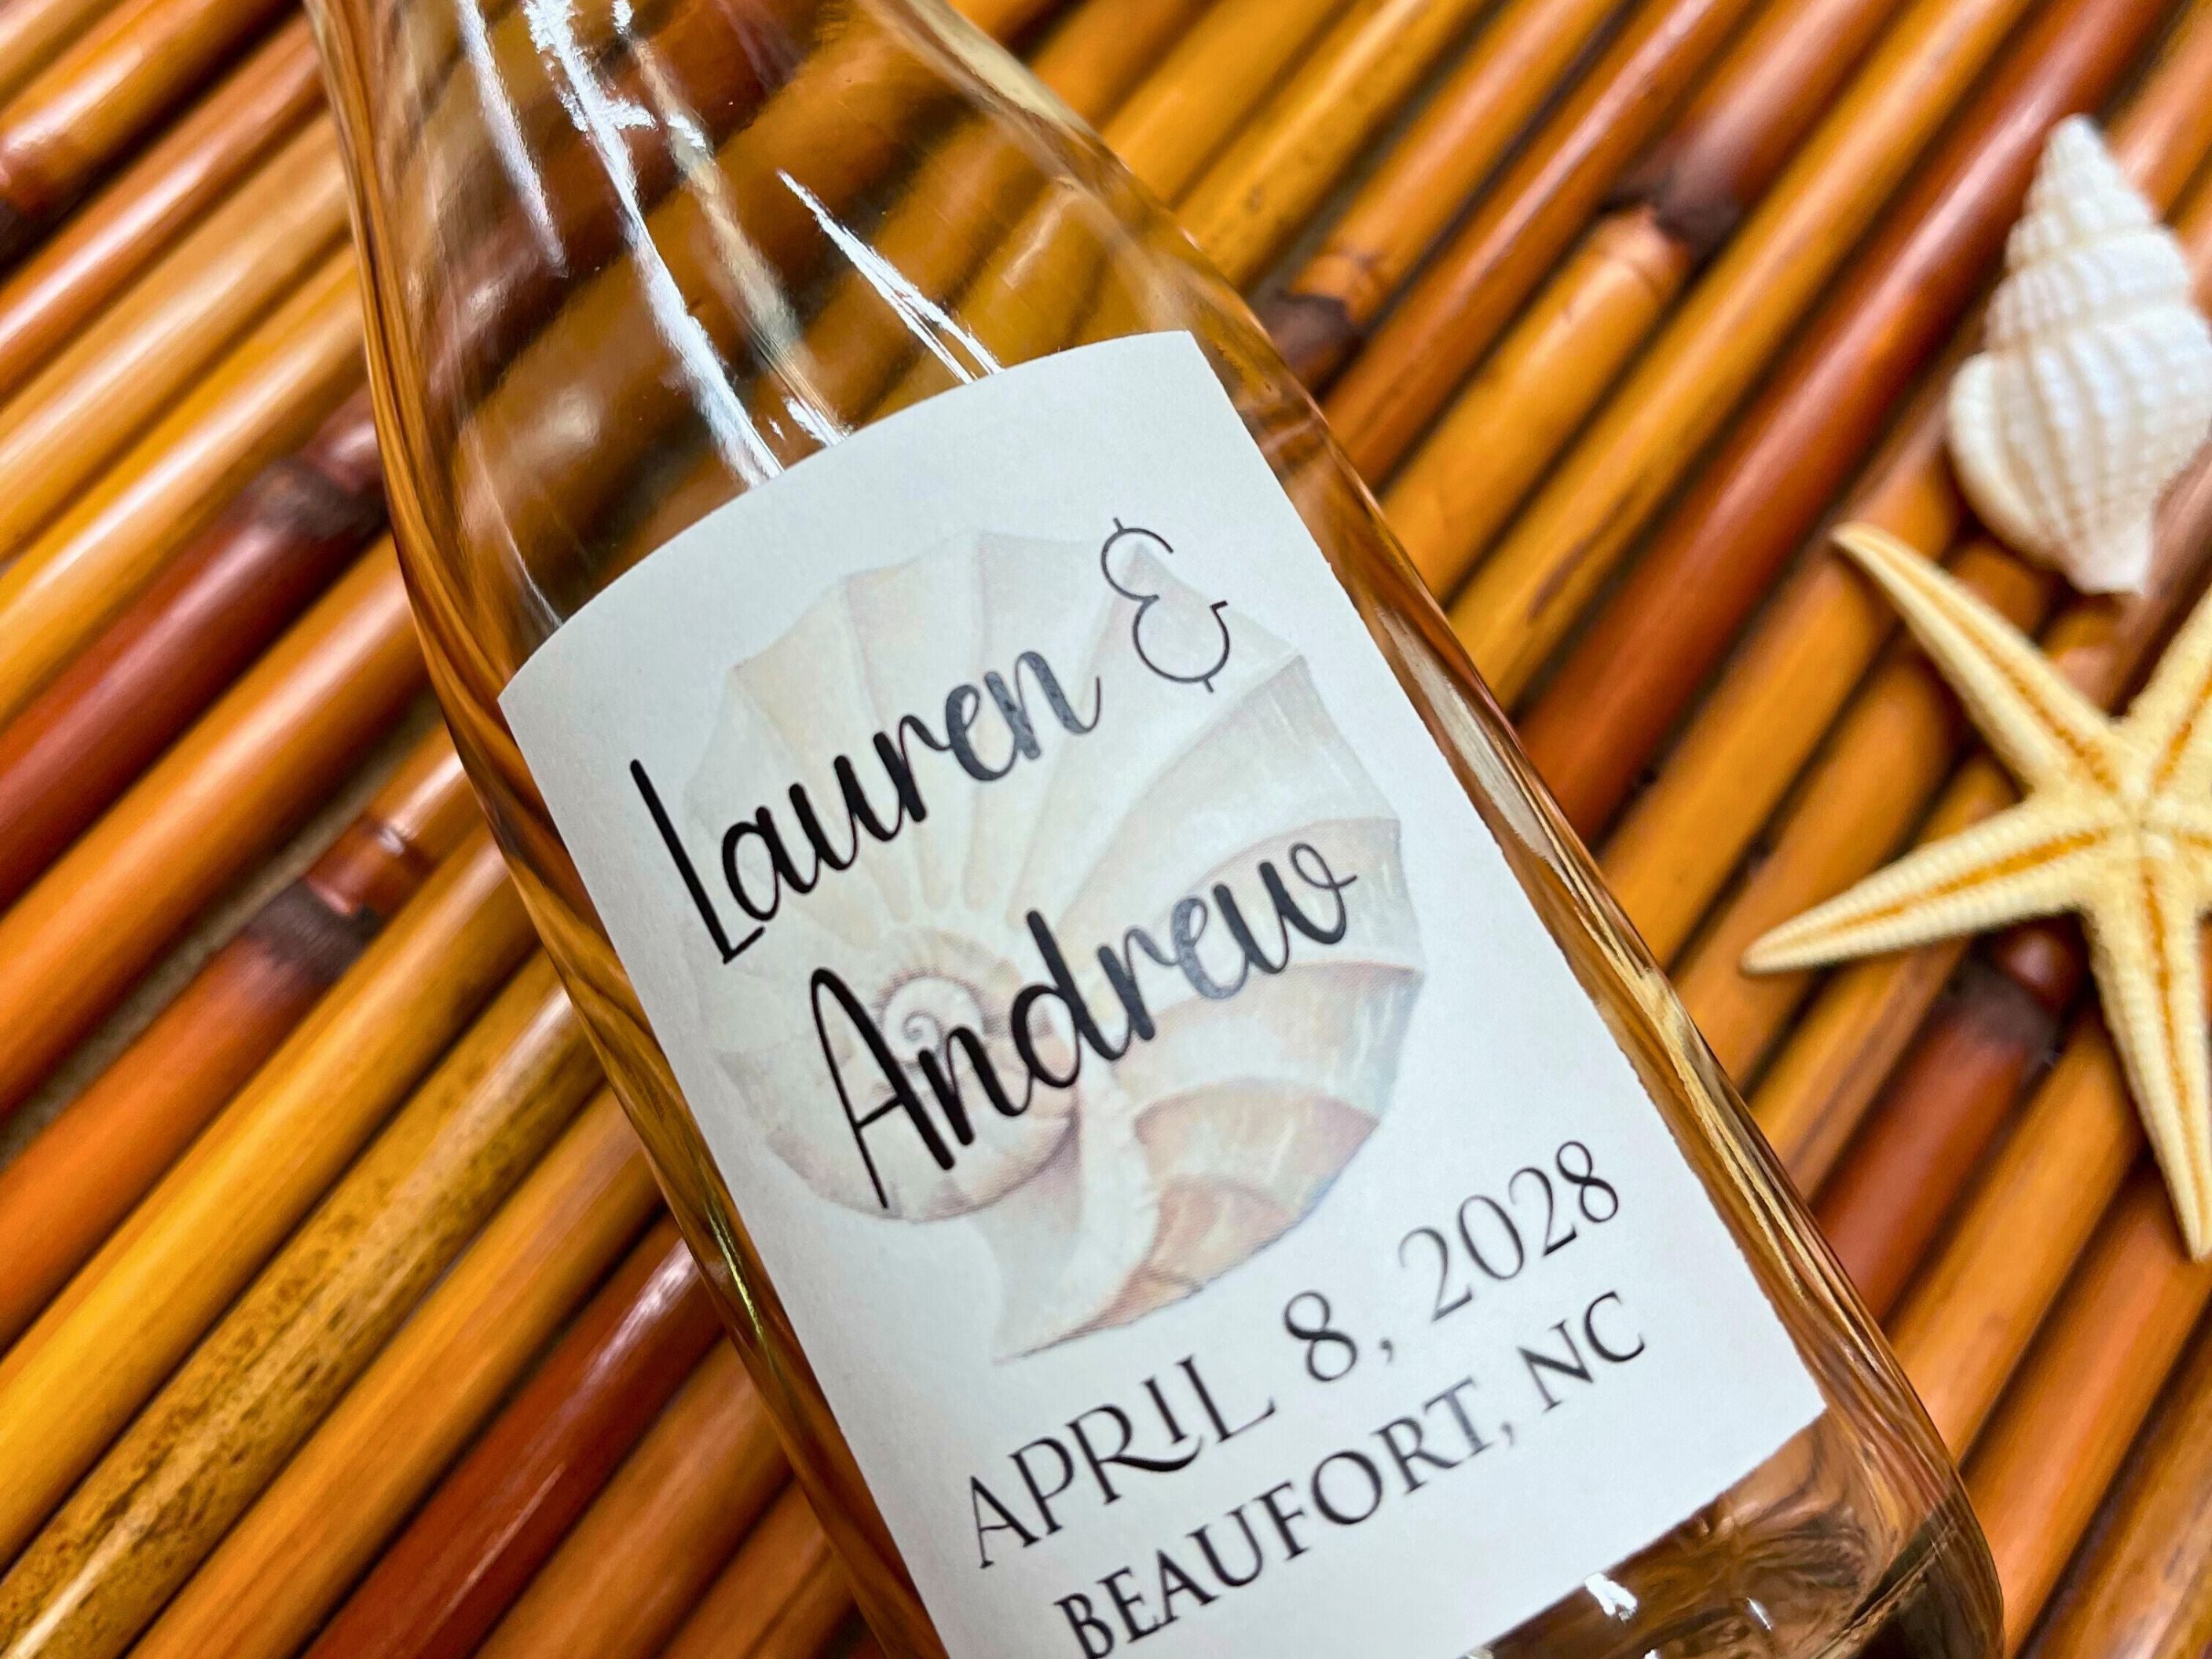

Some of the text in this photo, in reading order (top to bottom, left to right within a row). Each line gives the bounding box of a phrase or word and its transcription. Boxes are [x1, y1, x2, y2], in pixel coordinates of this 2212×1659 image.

[629, 517, 1230, 965] Lauren &
[810, 842, 1357, 1210] Andrew
[969, 1140, 1620, 1569] APRIL 8, 2028
[1053, 1291, 1646, 1659] BEAUFORT, NC
